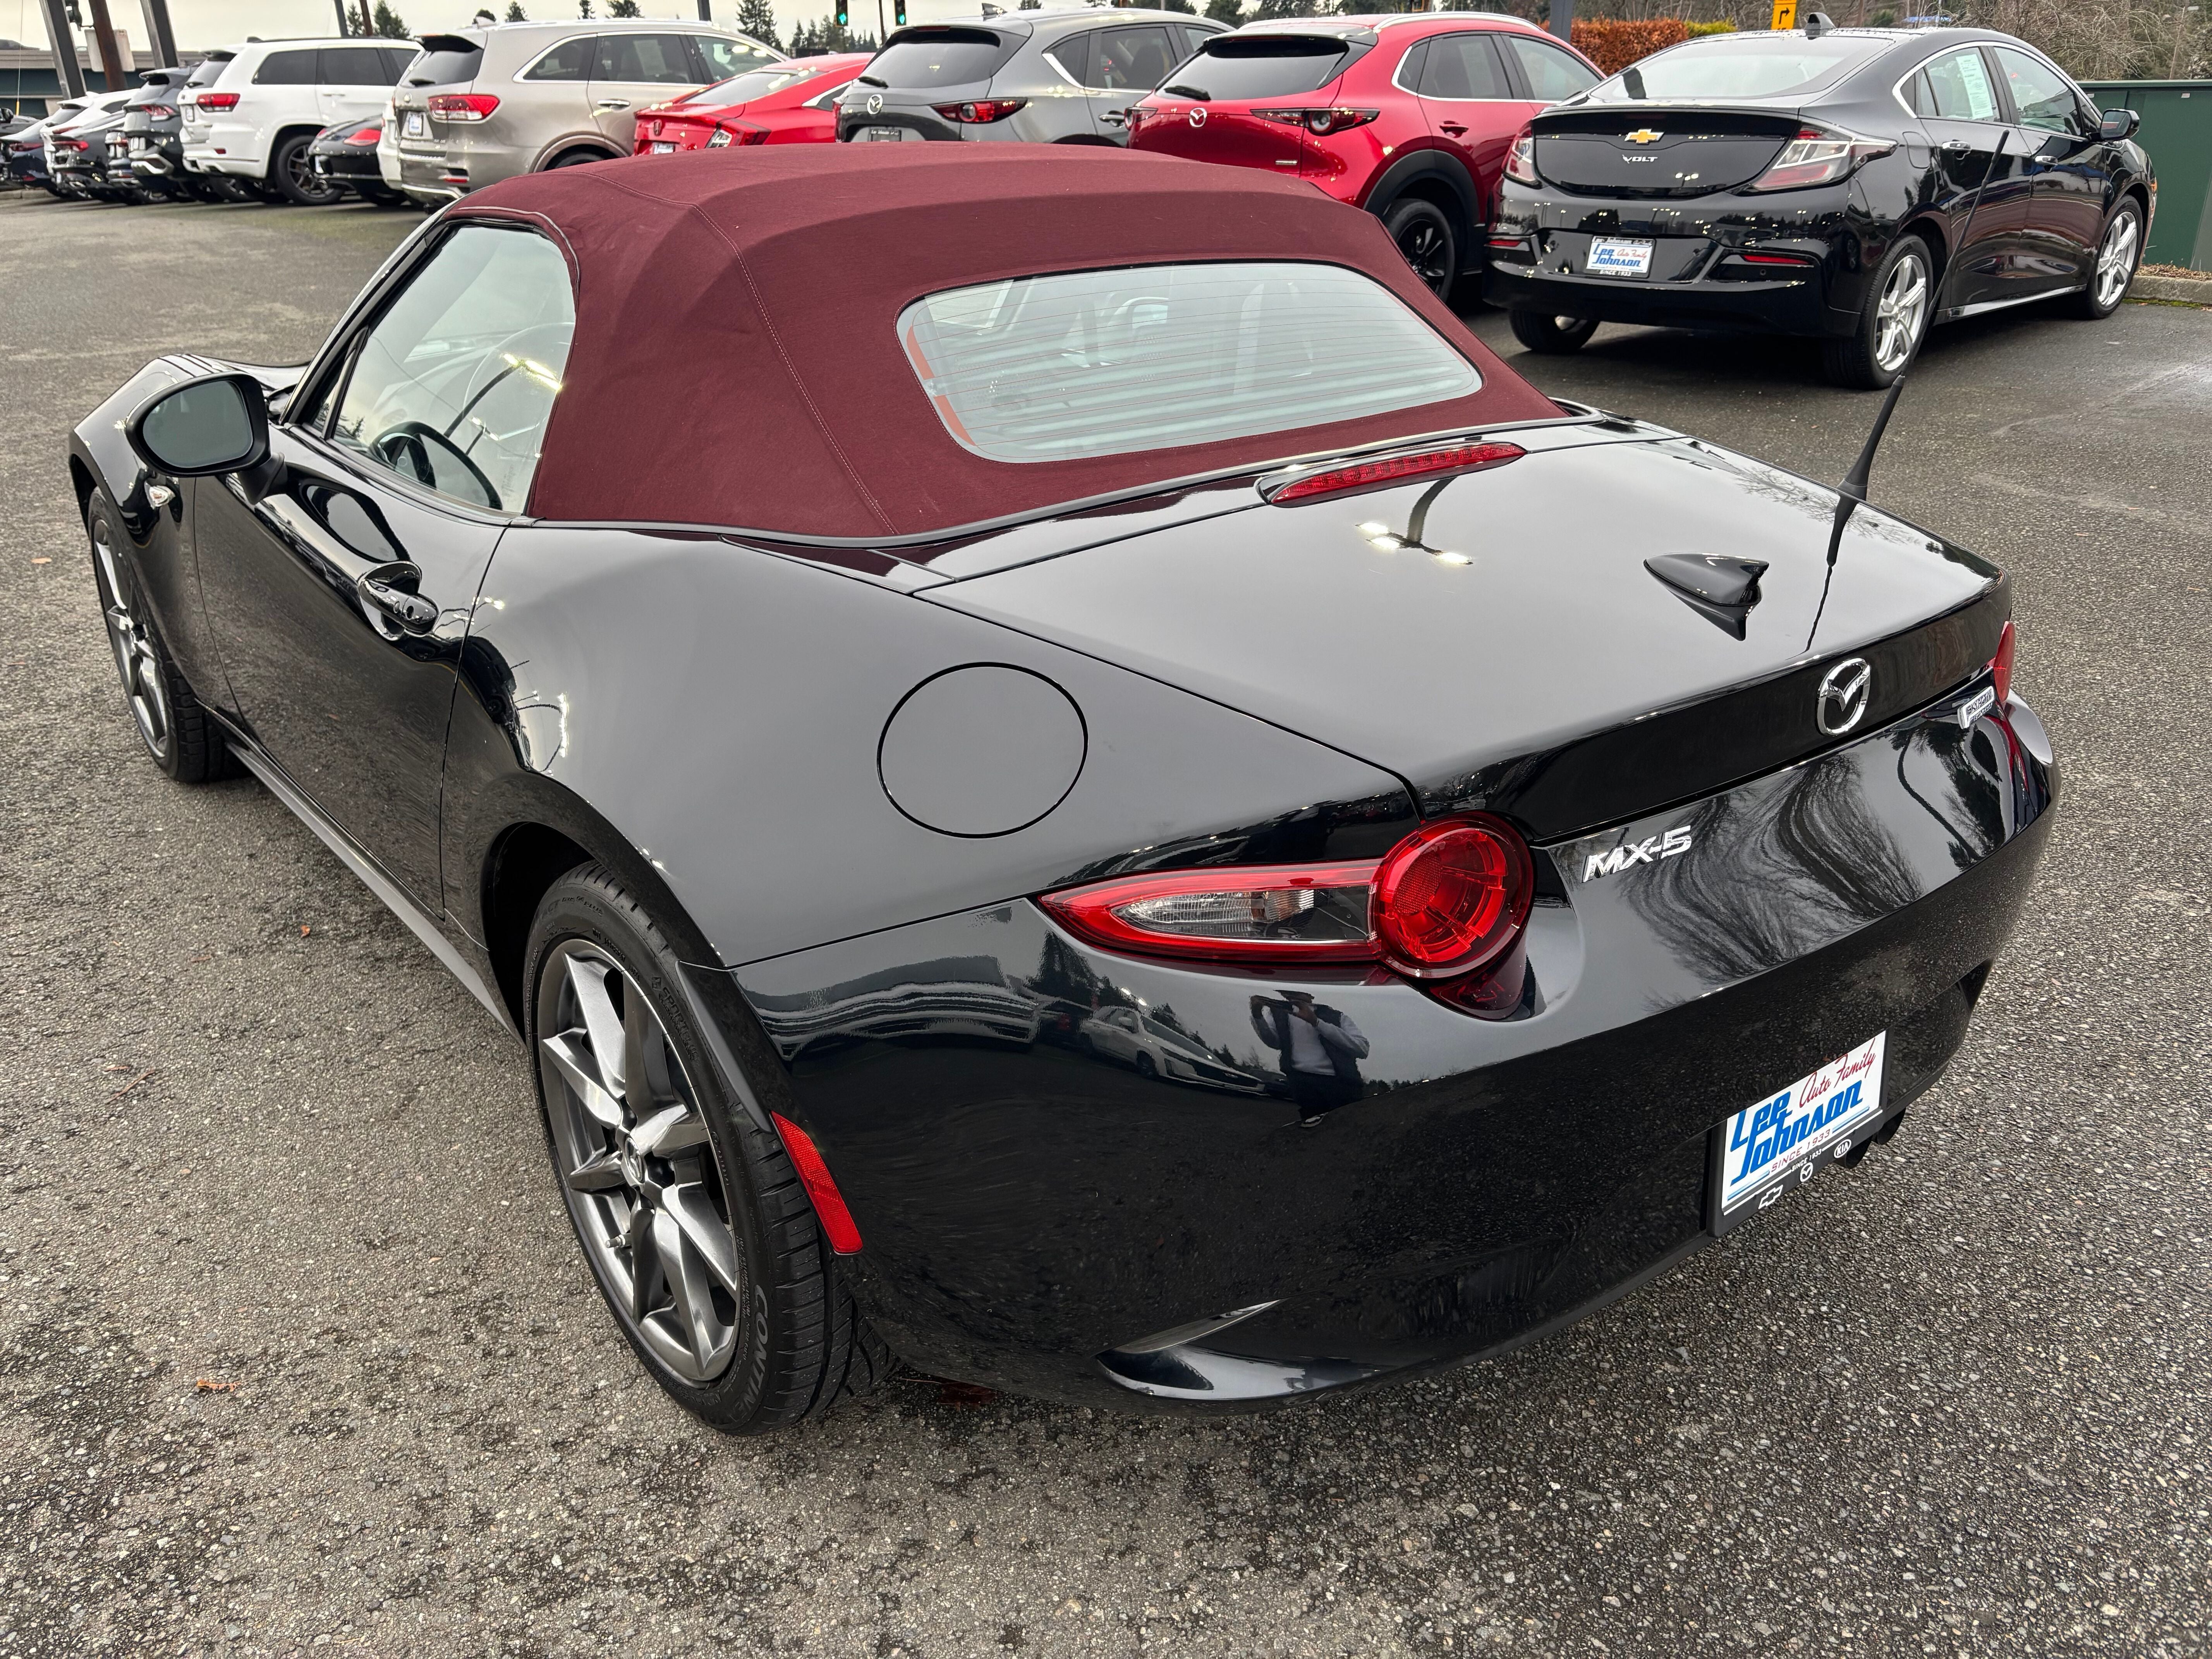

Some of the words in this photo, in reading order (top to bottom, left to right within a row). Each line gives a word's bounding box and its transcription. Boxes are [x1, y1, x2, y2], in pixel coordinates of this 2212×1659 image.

[1622, 155, 1658, 163] VOLT
[1592, 254, 1641, 267] Johnson
[1593, 244, 1615, 256] Lee
[1966, 689, 1993, 716] SKYACTIV
[1580, 825, 1692, 883] MX-5
[1730, 1091, 1793, 1152] Lee
[1799, 1072, 1832, 1108] Auto
[1833, 1037, 1876, 1088] Family
[1729, 1080, 1863, 1187] Johnson
[1771, 1147, 1802, 1173] SINCE
[1807, 1128, 1831, 1152] 1933
[1791, 1157, 1808, 1172] SINCE
[1809, 1149, 1822, 1162] 1933
[1836, 1141, 1850, 1156] KIA
